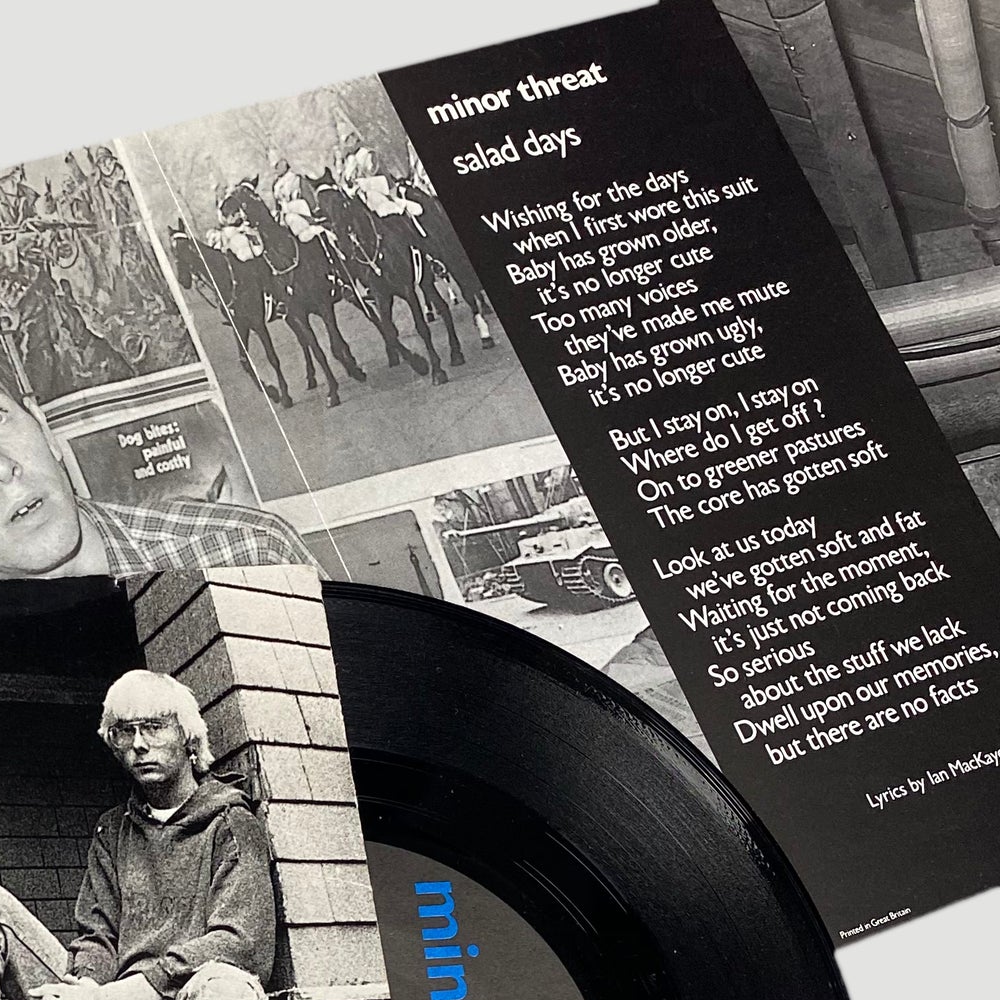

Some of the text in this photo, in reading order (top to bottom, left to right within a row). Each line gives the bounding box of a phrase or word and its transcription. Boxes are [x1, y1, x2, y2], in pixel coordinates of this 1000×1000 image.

[427, 63, 607, 124] minor threat
[454, 128, 581, 174] salad days
[481, 170, 688, 232] Wishing for the days
[513, 177, 758, 254] when I first wore this suit
[506, 218, 717, 284] Baby has grown older,
[573, 278, 600, 295] no
[601, 259, 662, 287] longer
[671, 247, 713, 268] cute
[531, 279, 698, 333] Too many voices
[642, 305, 697, 333] made
[701, 298, 734, 316] me
[737, 282, 790, 306] mute
[558, 316, 762, 386] Baby has grown ugly,
[624, 379, 651, 397] no
[653, 358, 715, 387] longer
[722, 346, 765, 367] cute
[118, 422, 180, 448] Dog bites:
[609, 379, 818, 450] But I stay on, I stay on
[620, 399, 825, 474] Where do I get off ?
[134, 454, 191, 480] and costly
[142, 435, 187, 462] painful
[638, 423, 865, 501] On to greener pastures
[647, 441, 888, 528] The core has gotten soft
[653, 517, 815, 579] Look at us today
[750, 549, 815, 586] gotten
[817, 531, 857, 558] soft
[858, 516, 894, 544] and
[895, 511, 926, 532] fat
[678, 542, 929, 631] Waiting for the moment,
[747, 618, 788, 649] just
[789, 606, 825, 629] not
[827, 581, 903, 615] coming
[899, 561, 951, 591] back
[708, 642, 815, 687] So serious
[734, 644, 998, 743] Dwell upon our memories,
[741, 618, 966, 709] about the stuff we lack
[765, 679, 978, 764] but there are no facts
[866, 786, 907, 809] Lyrics
[908, 778, 924, 794] by
[927, 771, 949, 784] Ian
[839, 924, 864, 939] Printed
[871, 916, 890, 927] Great
[888, 907, 911, 920] Britain
